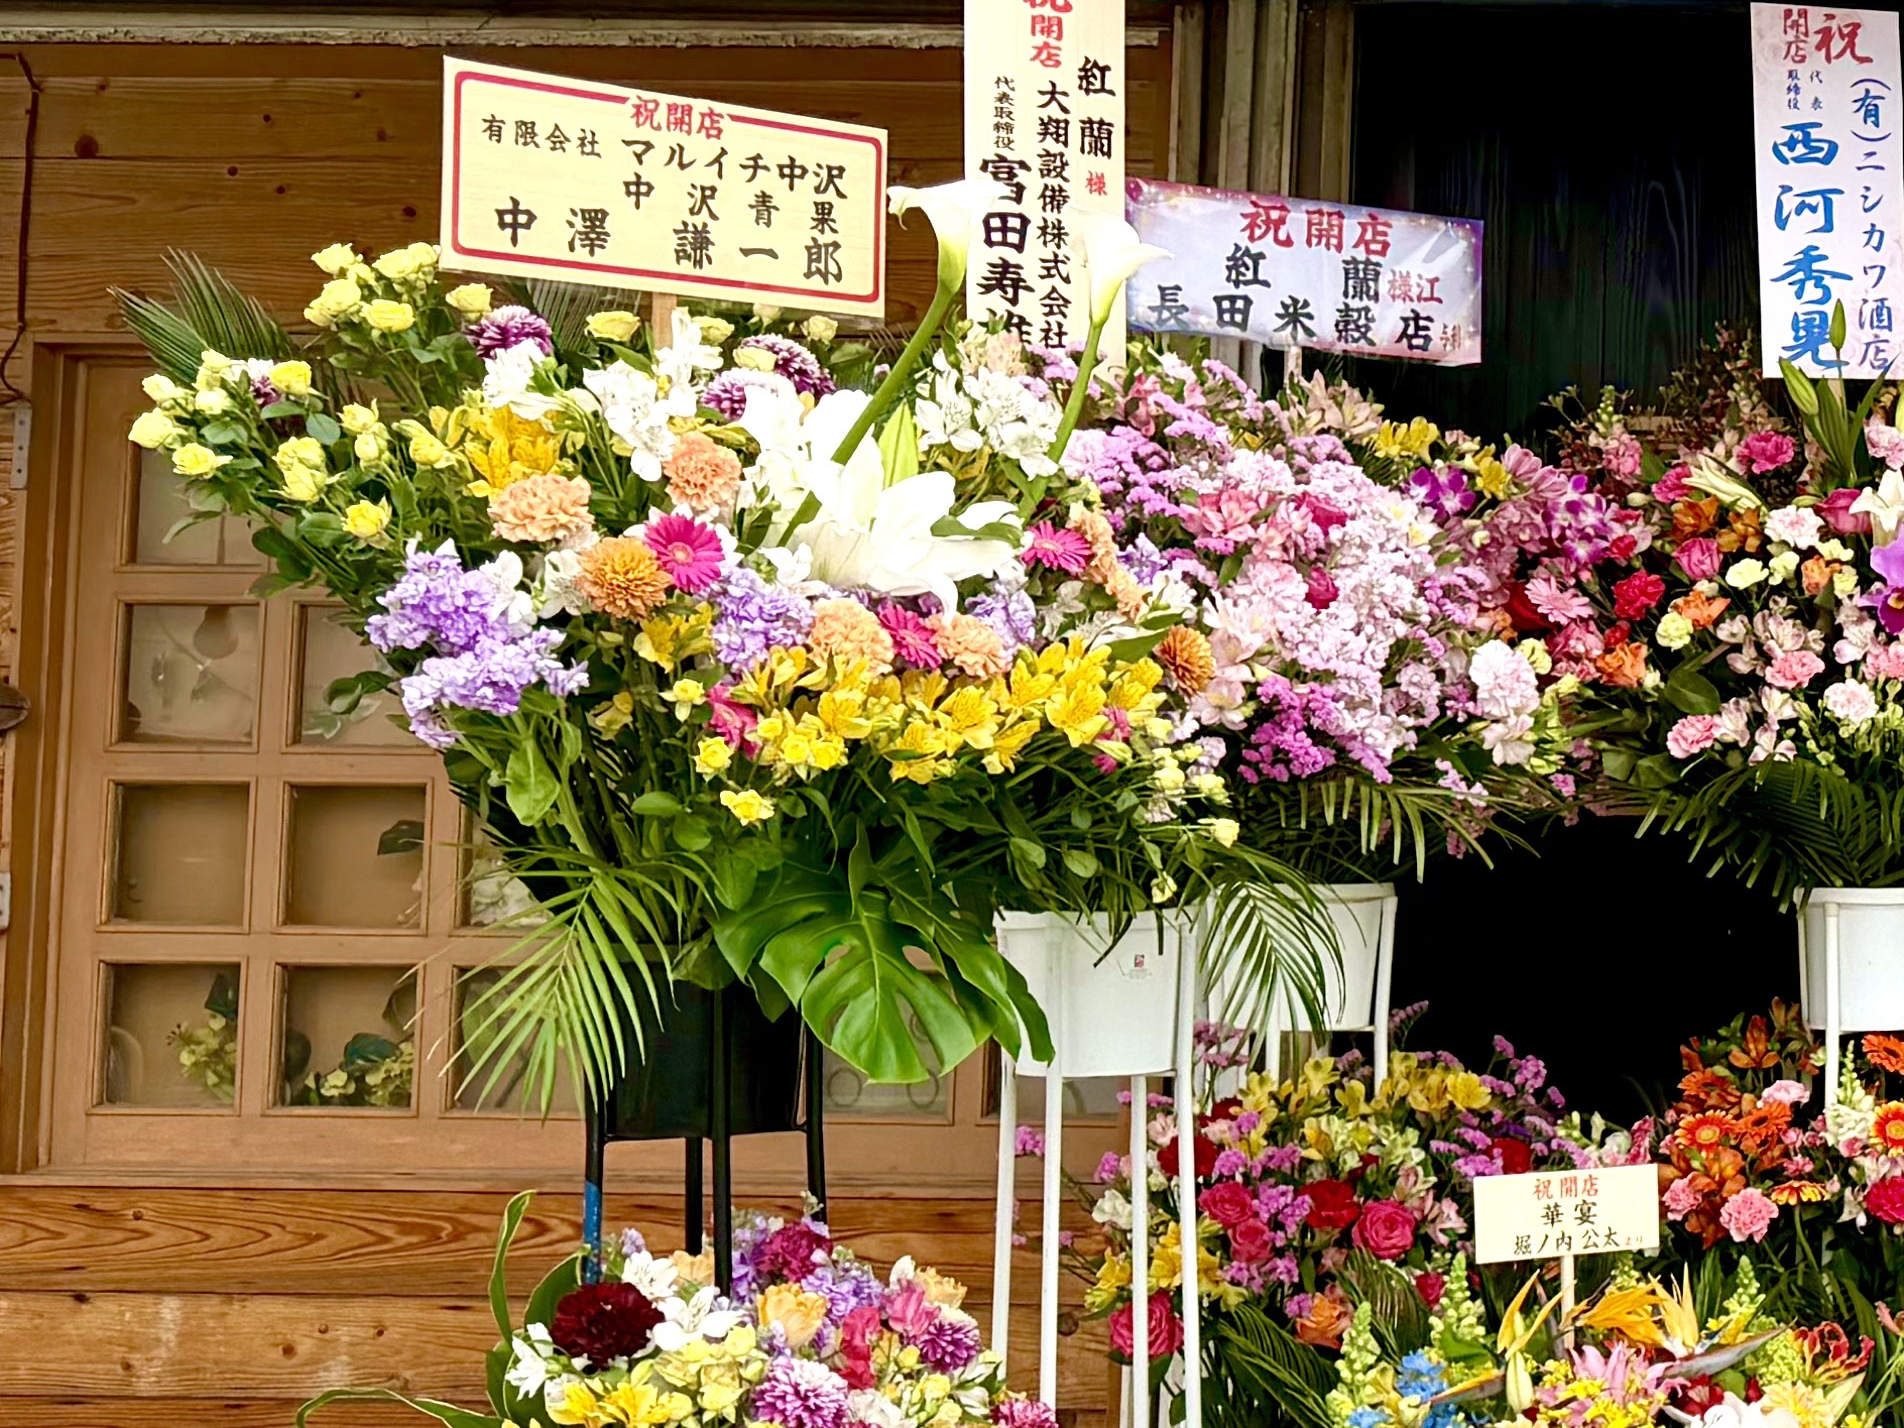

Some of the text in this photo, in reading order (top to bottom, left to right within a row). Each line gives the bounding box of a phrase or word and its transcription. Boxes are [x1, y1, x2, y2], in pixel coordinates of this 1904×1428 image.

[1782, 7, 1874, 65] 祝 開店
[630, 94, 725, 140] 祝開店
[993, 75, 1016, 152] 代表取締役
[481, 113, 848, 199] 有限会社 マルイチ中沢
[1036, 80, 1072, 350] 大翔設備株式会社
[1240, 200, 1394, 258] 祝開店
[1532, 1174, 1599, 1201] 祝開店
